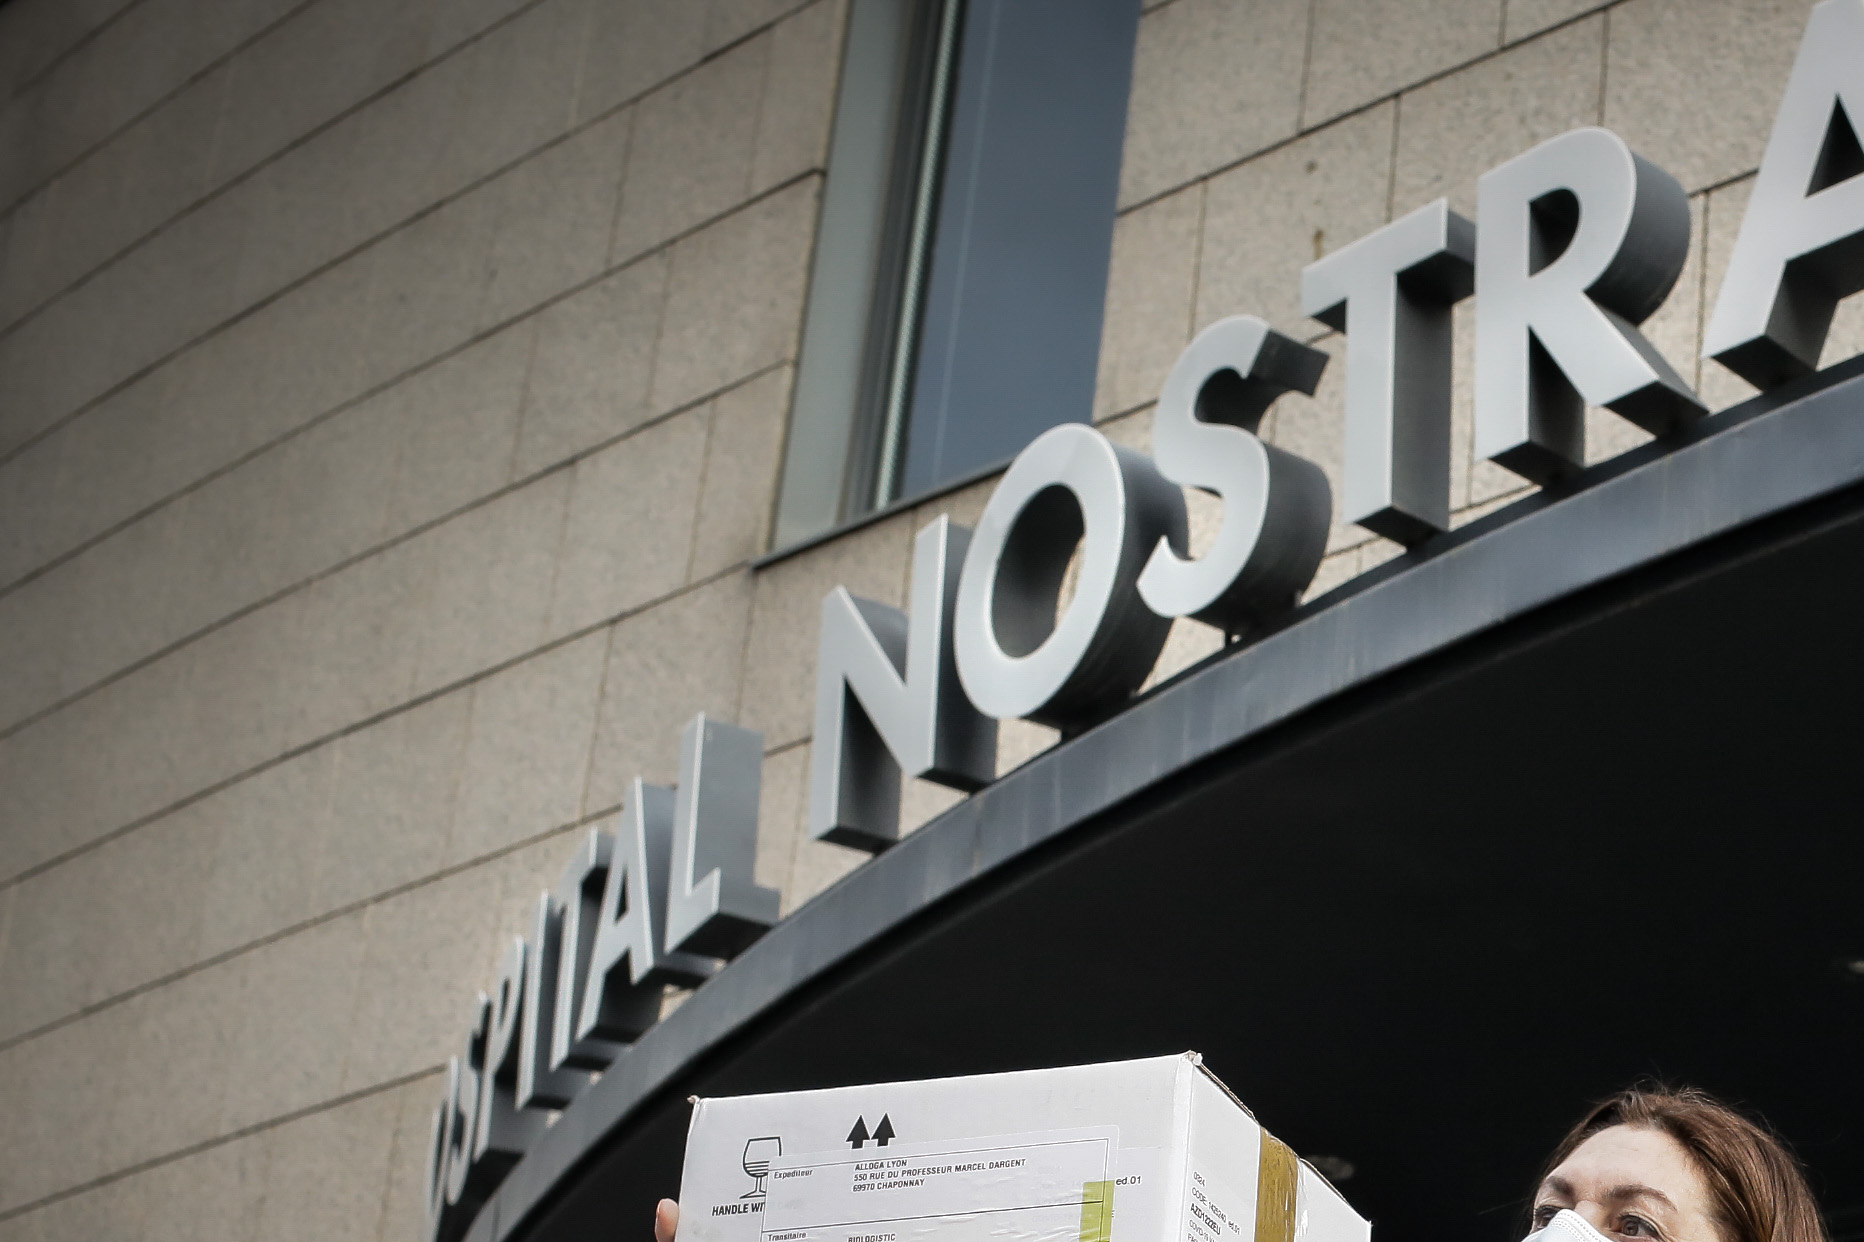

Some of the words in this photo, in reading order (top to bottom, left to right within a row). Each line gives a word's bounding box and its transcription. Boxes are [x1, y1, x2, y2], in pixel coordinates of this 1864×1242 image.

[854, 1173, 868, 1182] 550
[869, 1171, 885, 1180] RUE
[887, 1169, 899, 1179] DU
[901, 1165, 952, 1177] PROFESSEUR
[954, 1162, 986, 1173] MARCEL
[988, 1159, 1026, 1170] DARGENT
[855, 1160, 885, 1171] ALLOGA
[887, 1159, 907, 1169] LYON
[877, 1179, 925, 1190] CHAPONNAY
[1115, 1176, 1142, 1185] ed.01
[712, 1203, 749, 1216] HANDLE
[768, 1230, 807, 1242] Transitaire
